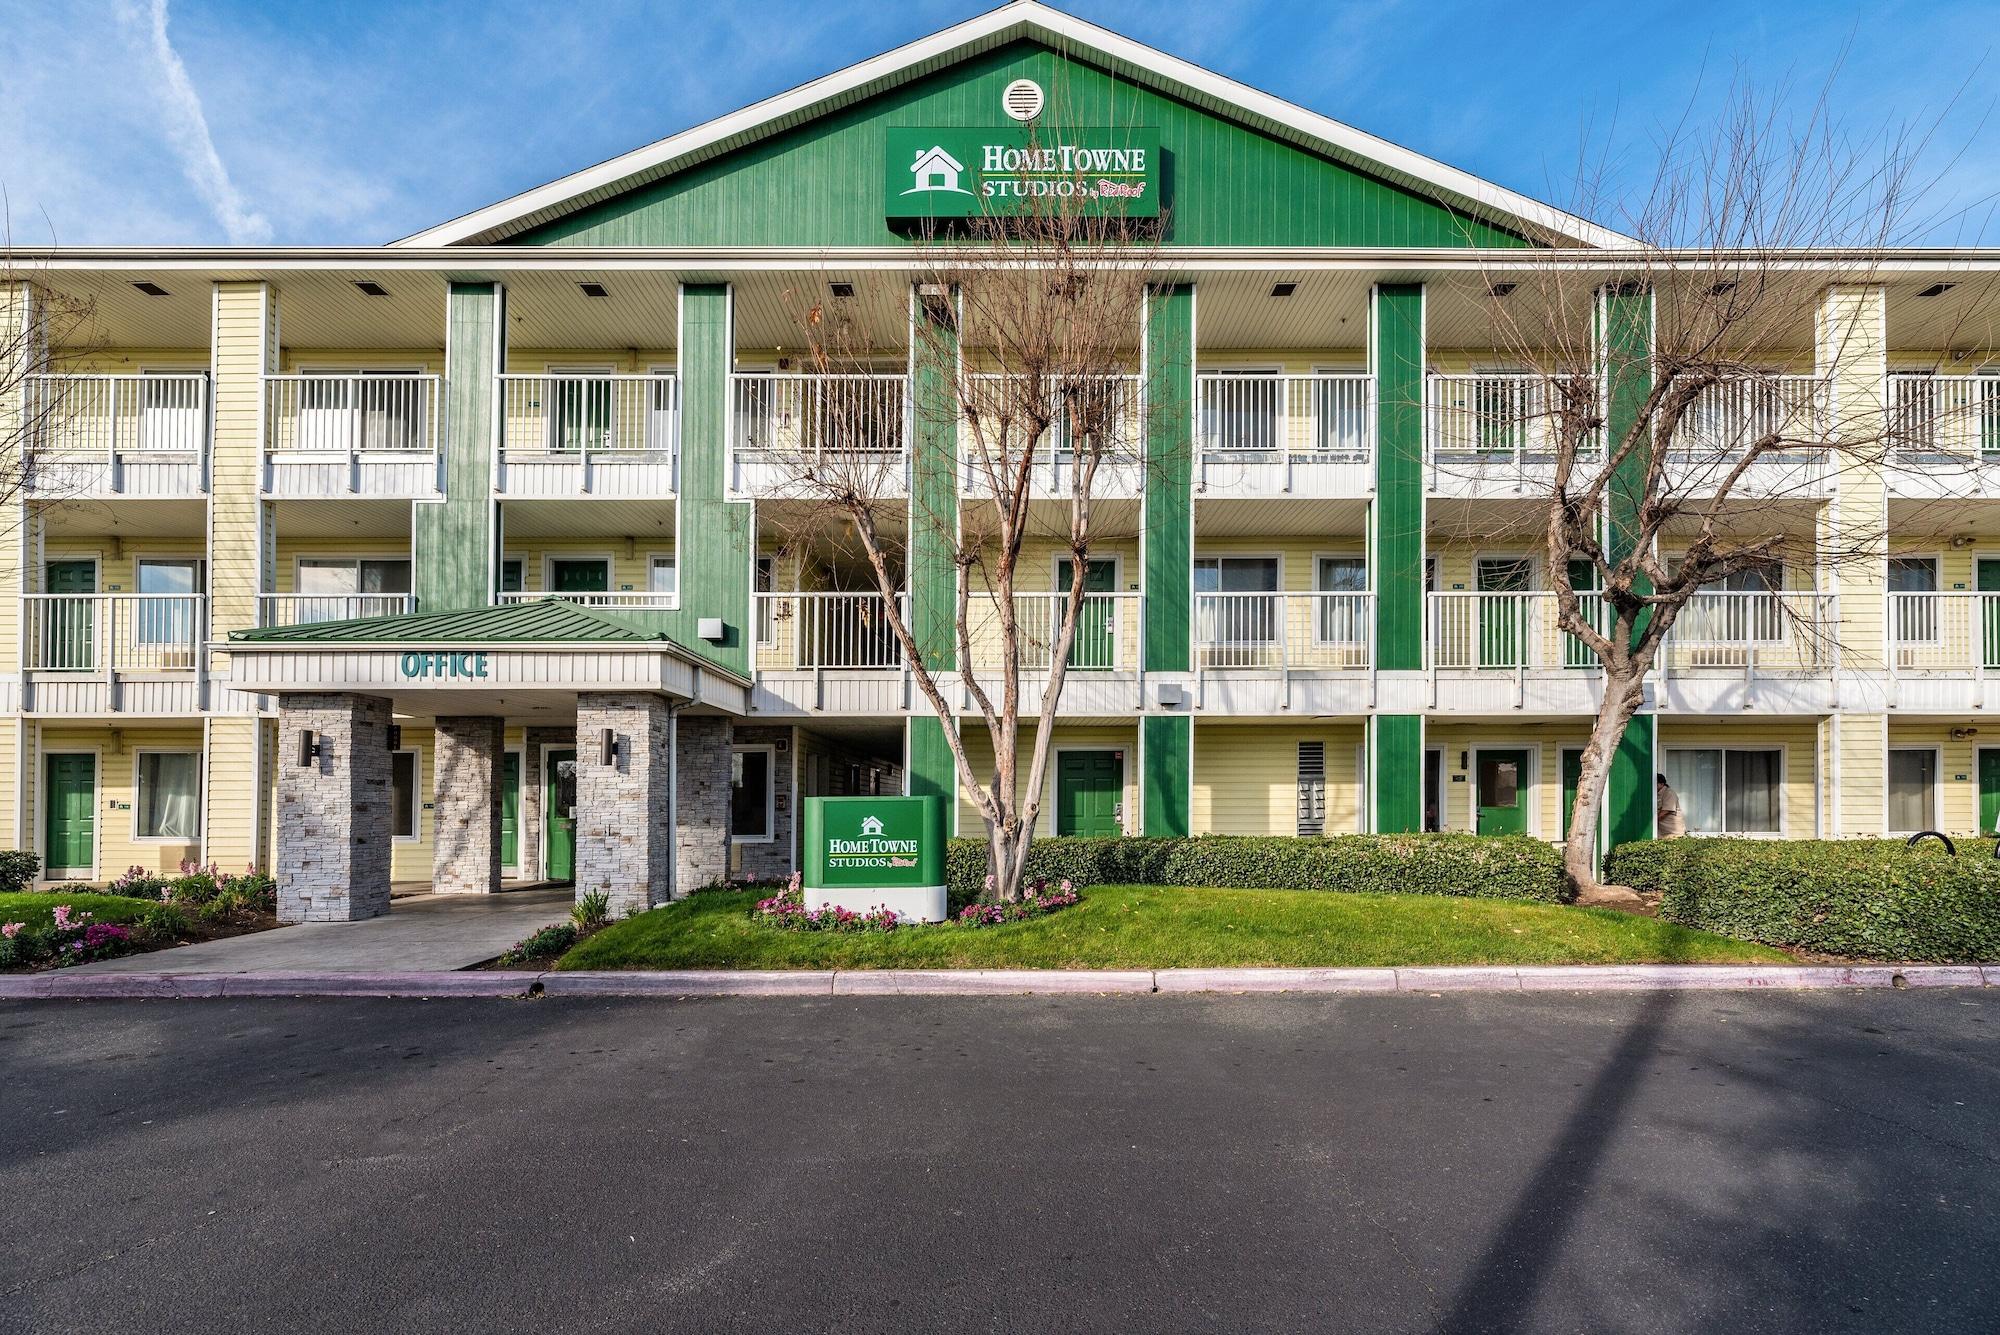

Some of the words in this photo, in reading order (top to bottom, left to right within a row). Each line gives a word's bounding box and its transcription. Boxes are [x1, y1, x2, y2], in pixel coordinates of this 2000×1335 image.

[983, 180, 1087, 197] STUDIOS
[401, 652, 488, 677] OFFICE
[829, 858, 886, 867] STUDIOS
